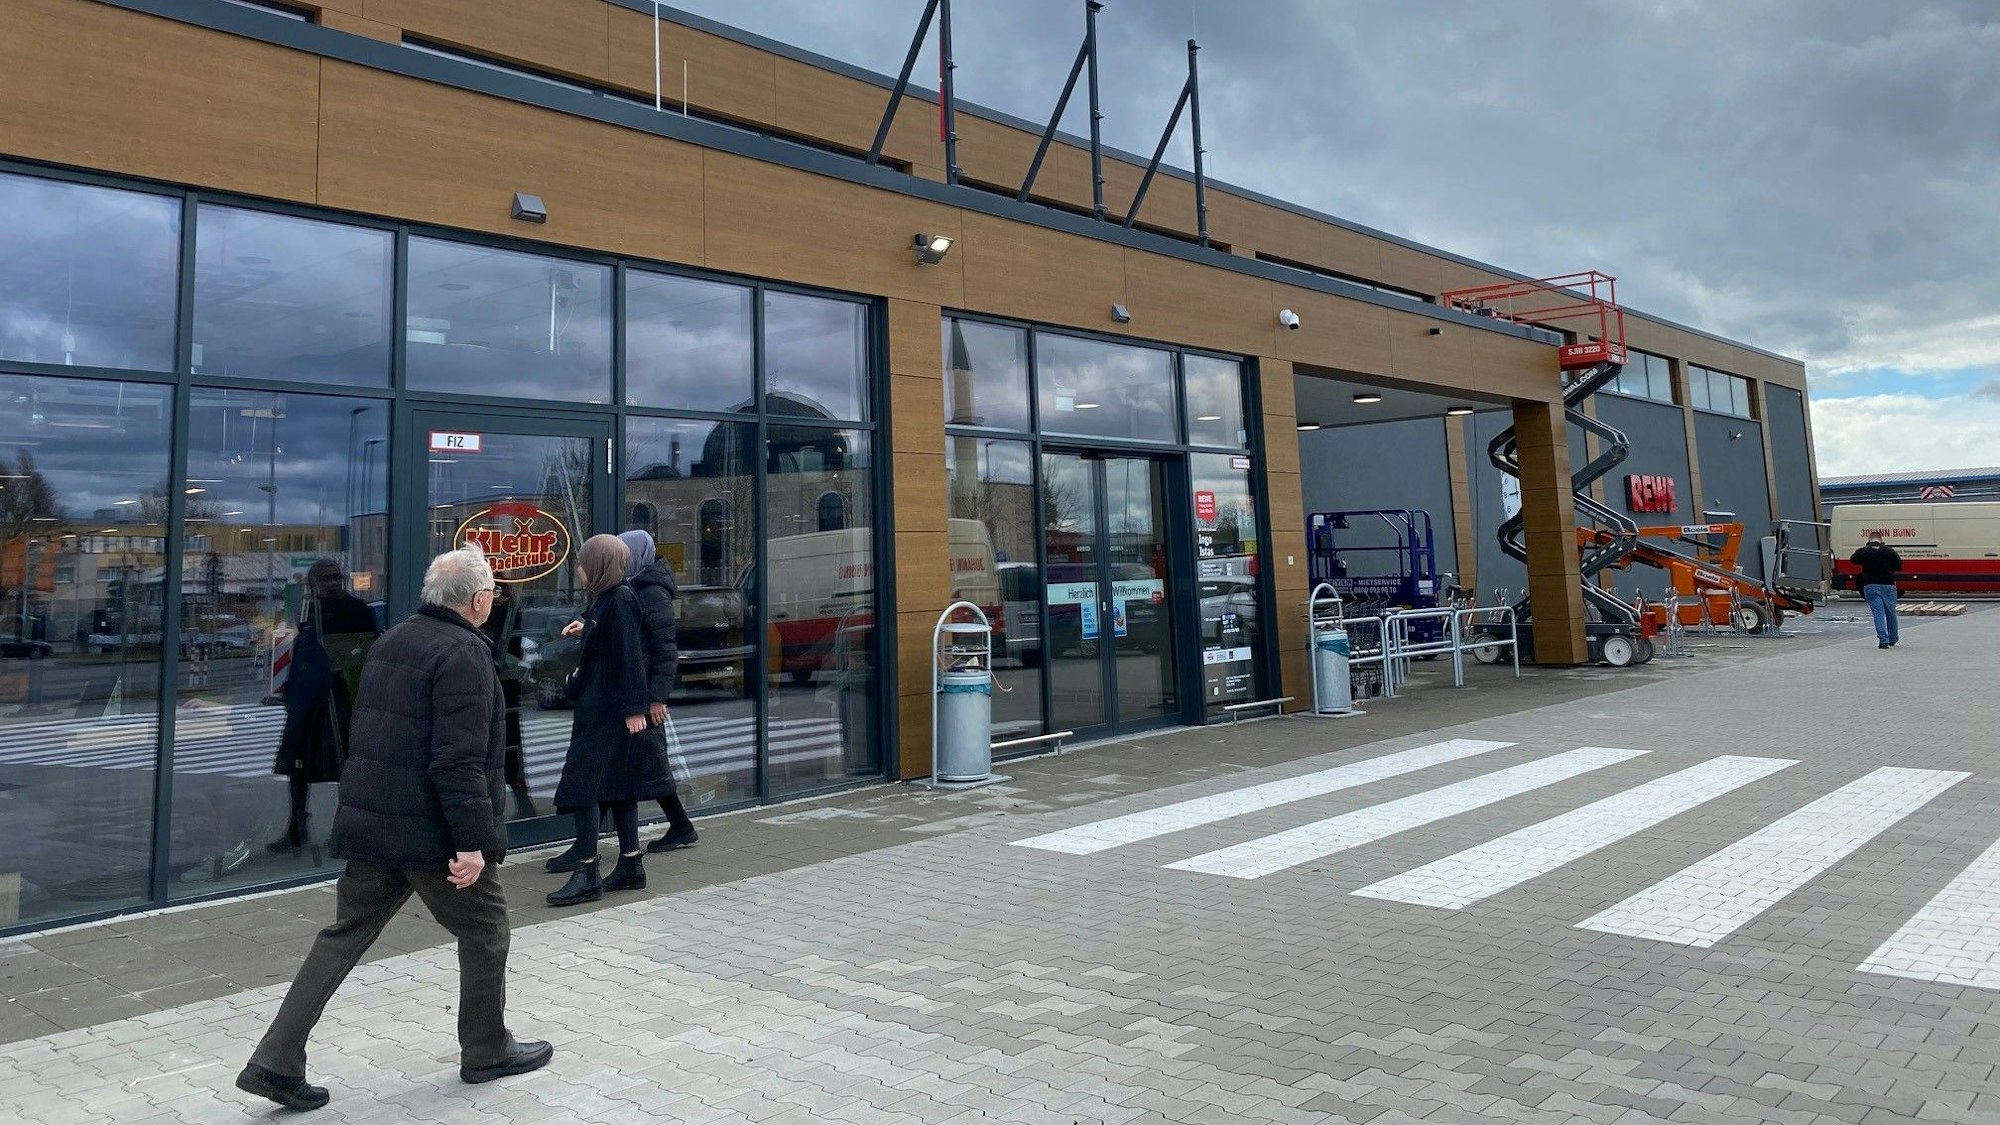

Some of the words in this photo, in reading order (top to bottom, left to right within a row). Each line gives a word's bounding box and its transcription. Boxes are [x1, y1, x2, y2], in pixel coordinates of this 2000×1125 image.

[1584, 345, 1601, 354] 3220
[447, 436, 464, 448] FIZ
[1628, 474, 1679, 513] REWE
[1683, 526, 1709, 534] Boels
[1198, 534, 1213, 547] Ingo
[1199, 545, 1215, 557] Istas
[488, 551, 555, 571] Backstube
[1696, 570, 1719, 582] Boels
[1068, 587, 1094, 600] Herzlich
[1111, 584, 1150, 598] Willkommen
